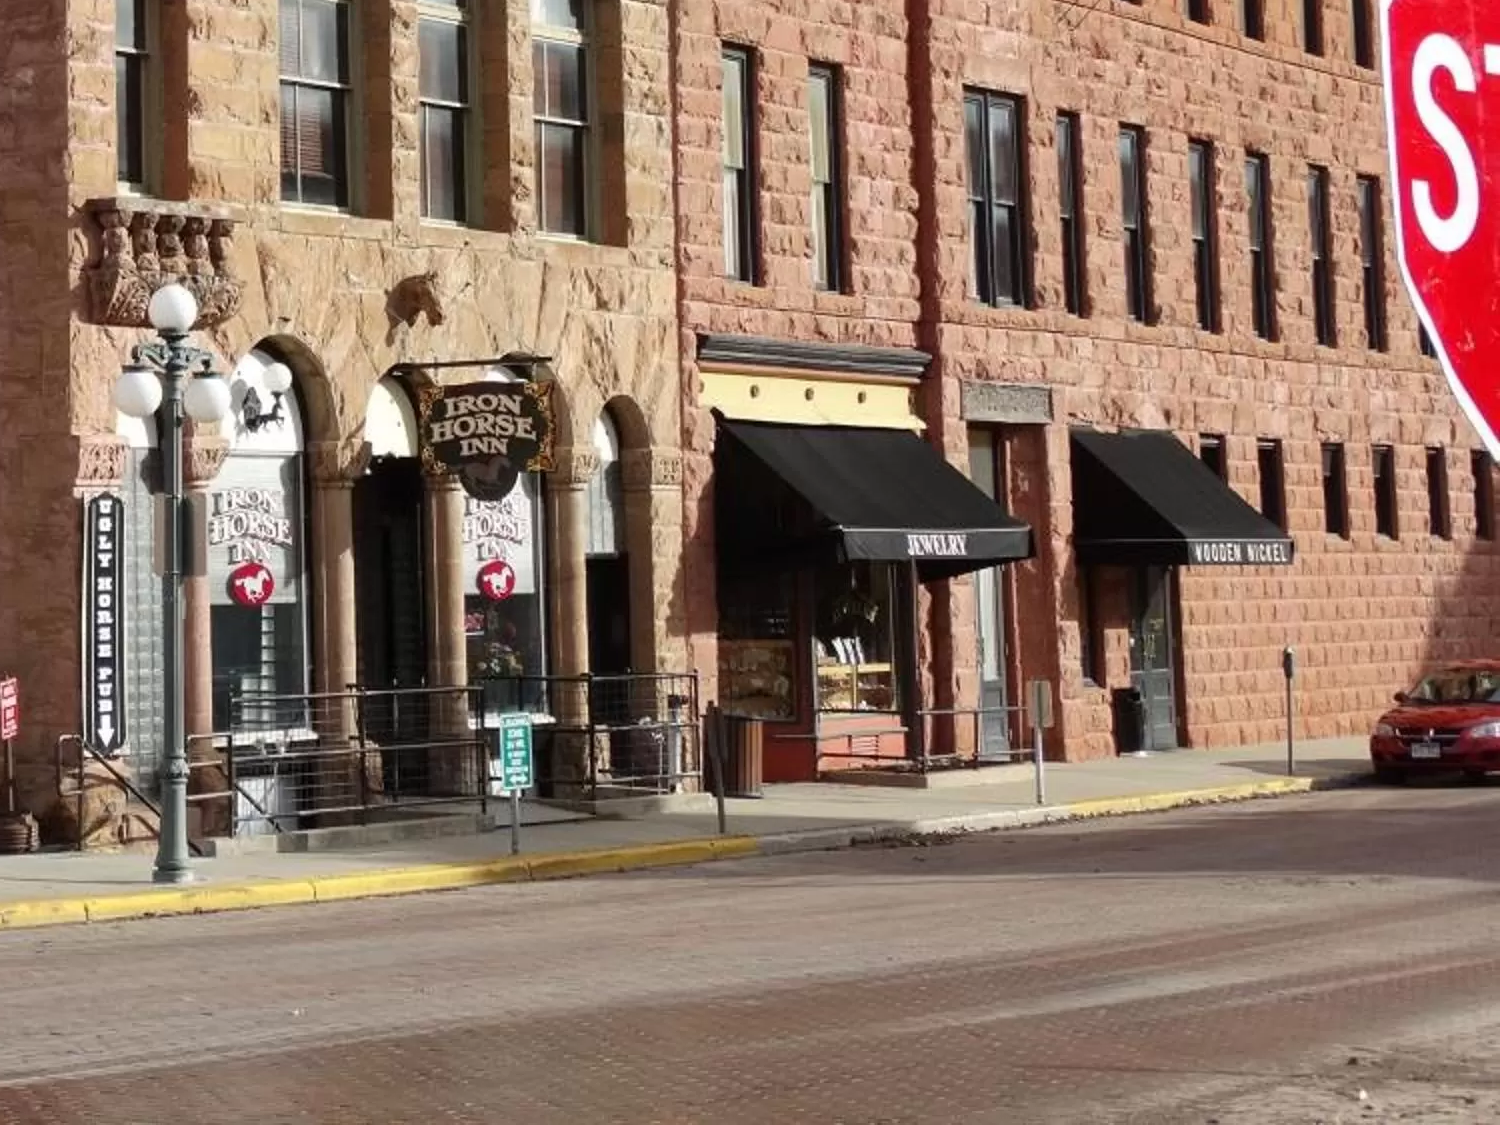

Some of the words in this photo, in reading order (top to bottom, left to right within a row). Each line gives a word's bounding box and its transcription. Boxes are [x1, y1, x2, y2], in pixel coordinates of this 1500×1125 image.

[1411, 32, 1500, 253] S
[443, 394, 523, 418] IRON
[430, 413, 537, 443] HORSE
[460, 436, 508, 456] INN
[217, 488, 284, 515] IRON
[211, 509, 293, 546] HORSE
[463, 508, 529, 543] HORSE
[233, 538, 271, 563] INN
[907, 534, 967, 556] JEWELRY
[1194, 542, 1242, 562] WOODEN
[1246, 542, 1288, 562] NICKEL
[97, 577, 113, 657] HORSE
[97, 667, 113, 712] PUB
